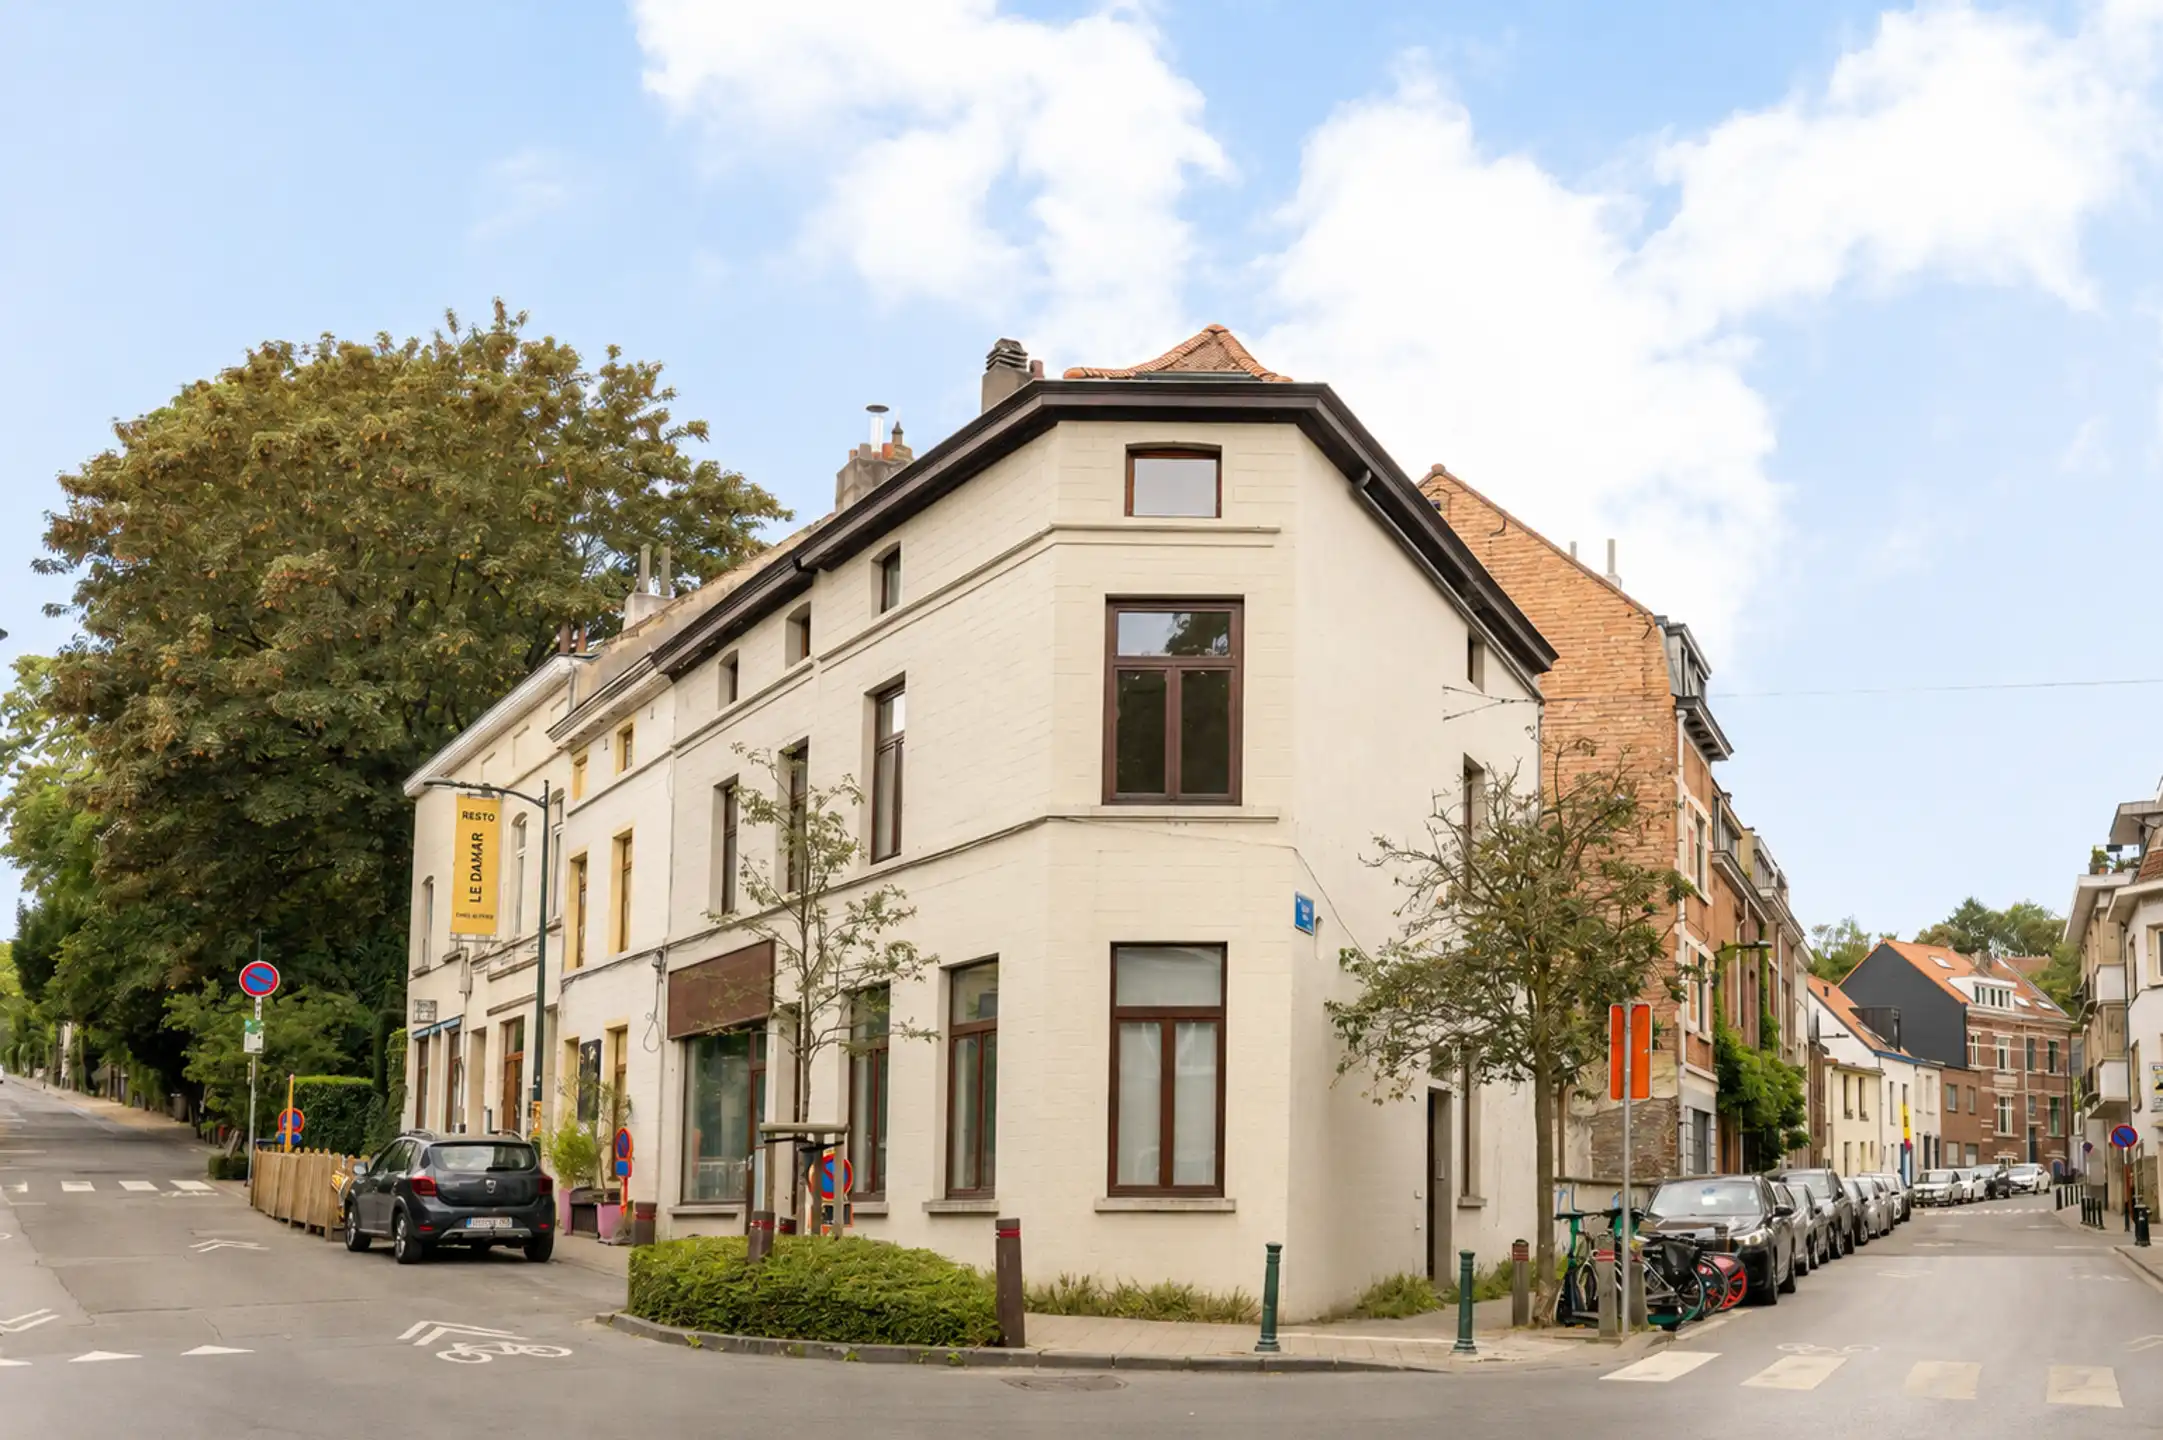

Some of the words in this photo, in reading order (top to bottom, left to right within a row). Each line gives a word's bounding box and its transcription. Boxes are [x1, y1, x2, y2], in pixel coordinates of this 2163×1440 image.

[462, 811, 495, 822] RESTO
[470, 832, 484, 881] DAMAR
[469, 886, 482, 903] LE
